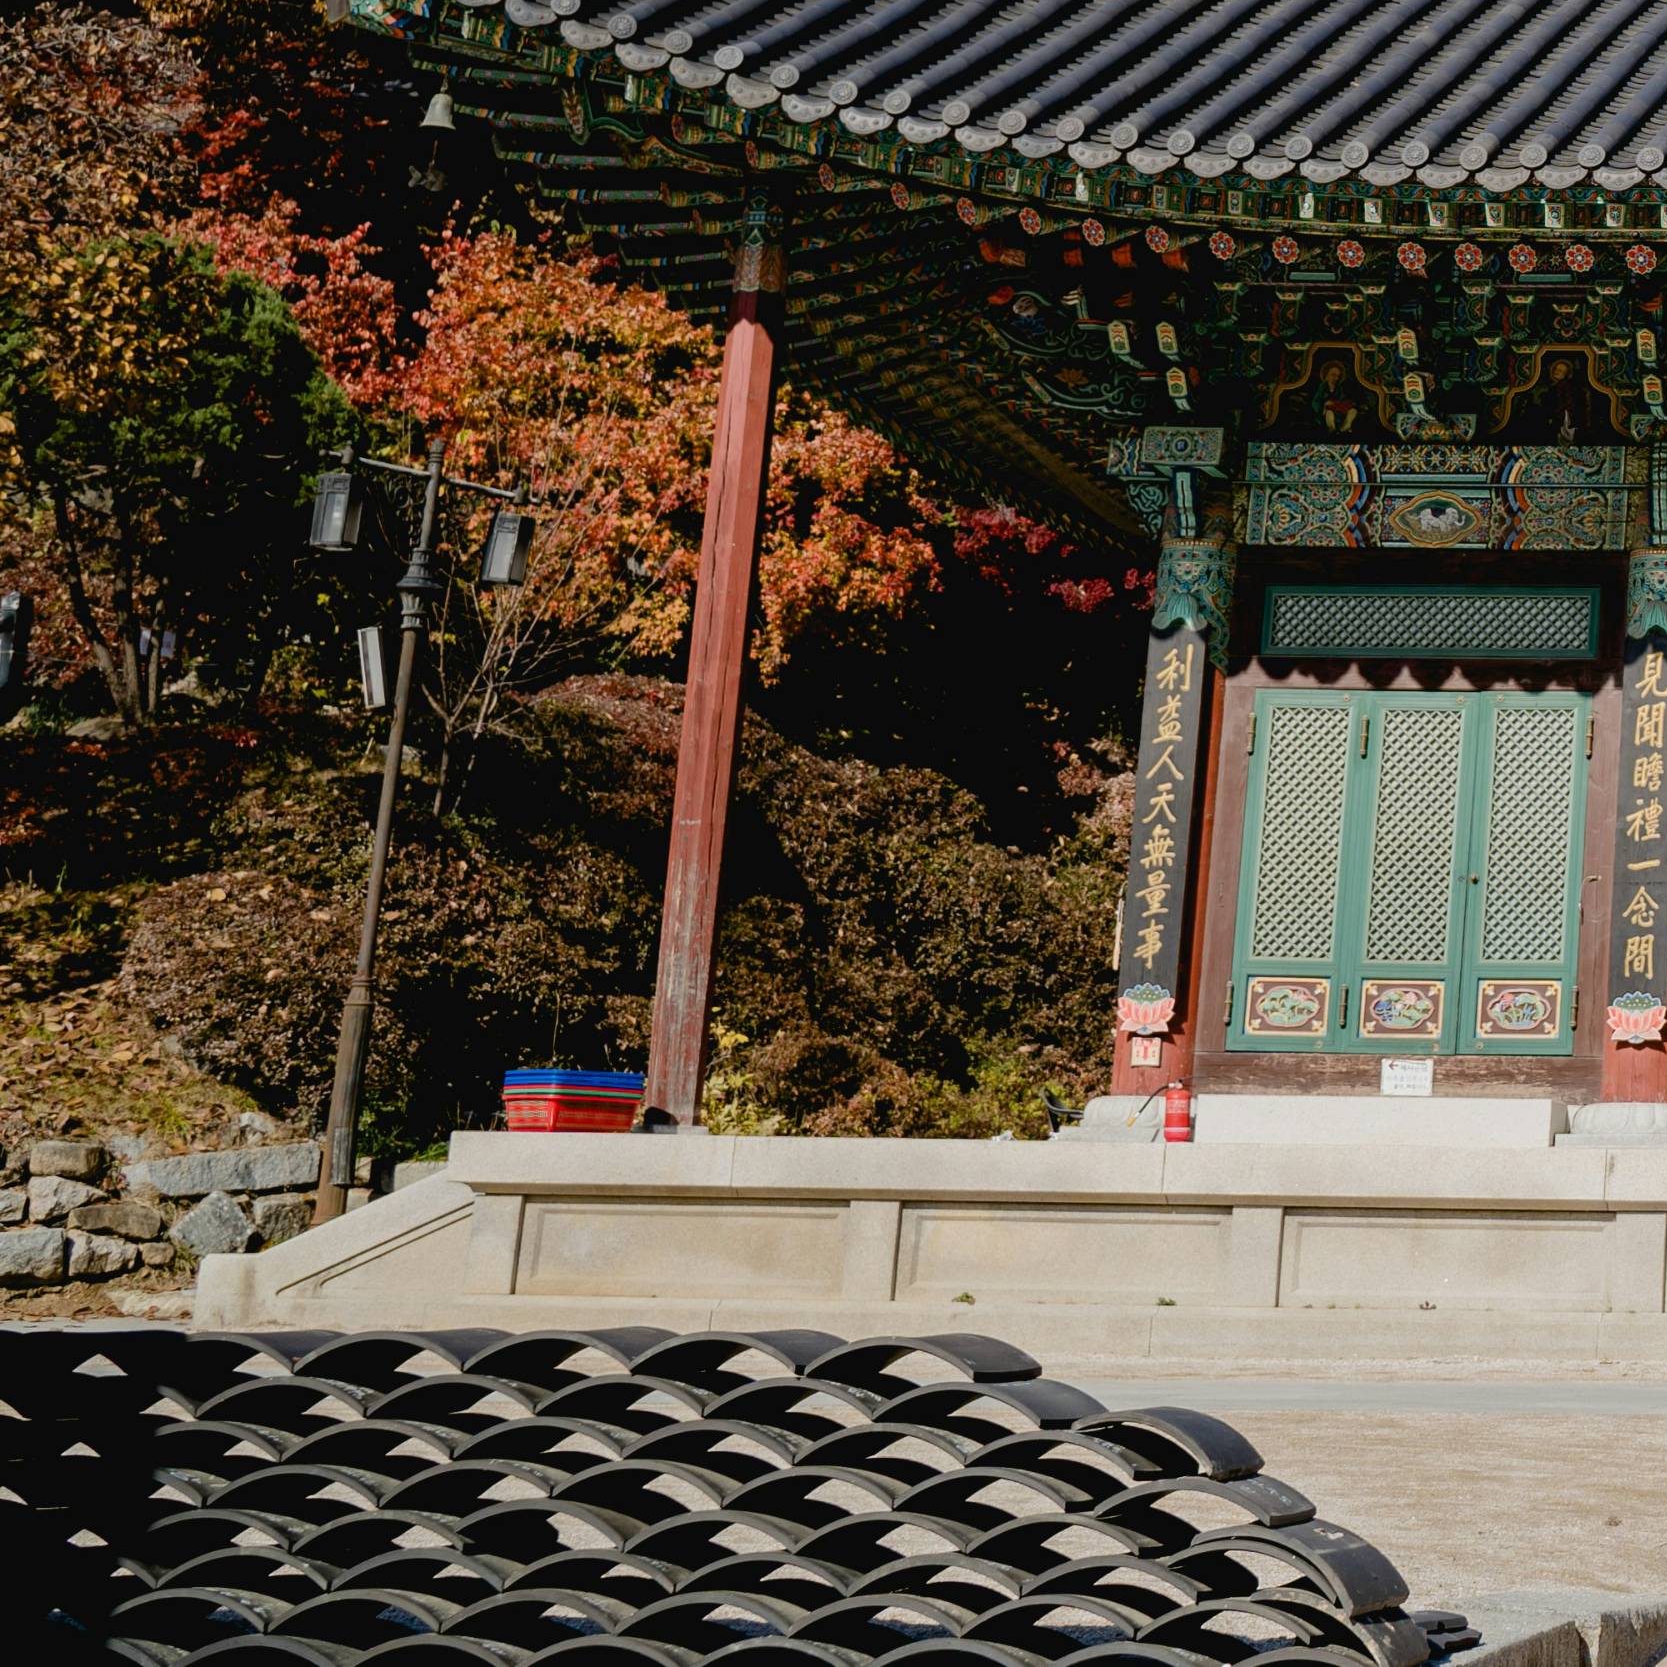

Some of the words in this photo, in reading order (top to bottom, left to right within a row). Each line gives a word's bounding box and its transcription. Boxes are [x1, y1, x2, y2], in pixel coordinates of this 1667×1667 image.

[1133, 643, 1193, 970] 利益人天無量事
